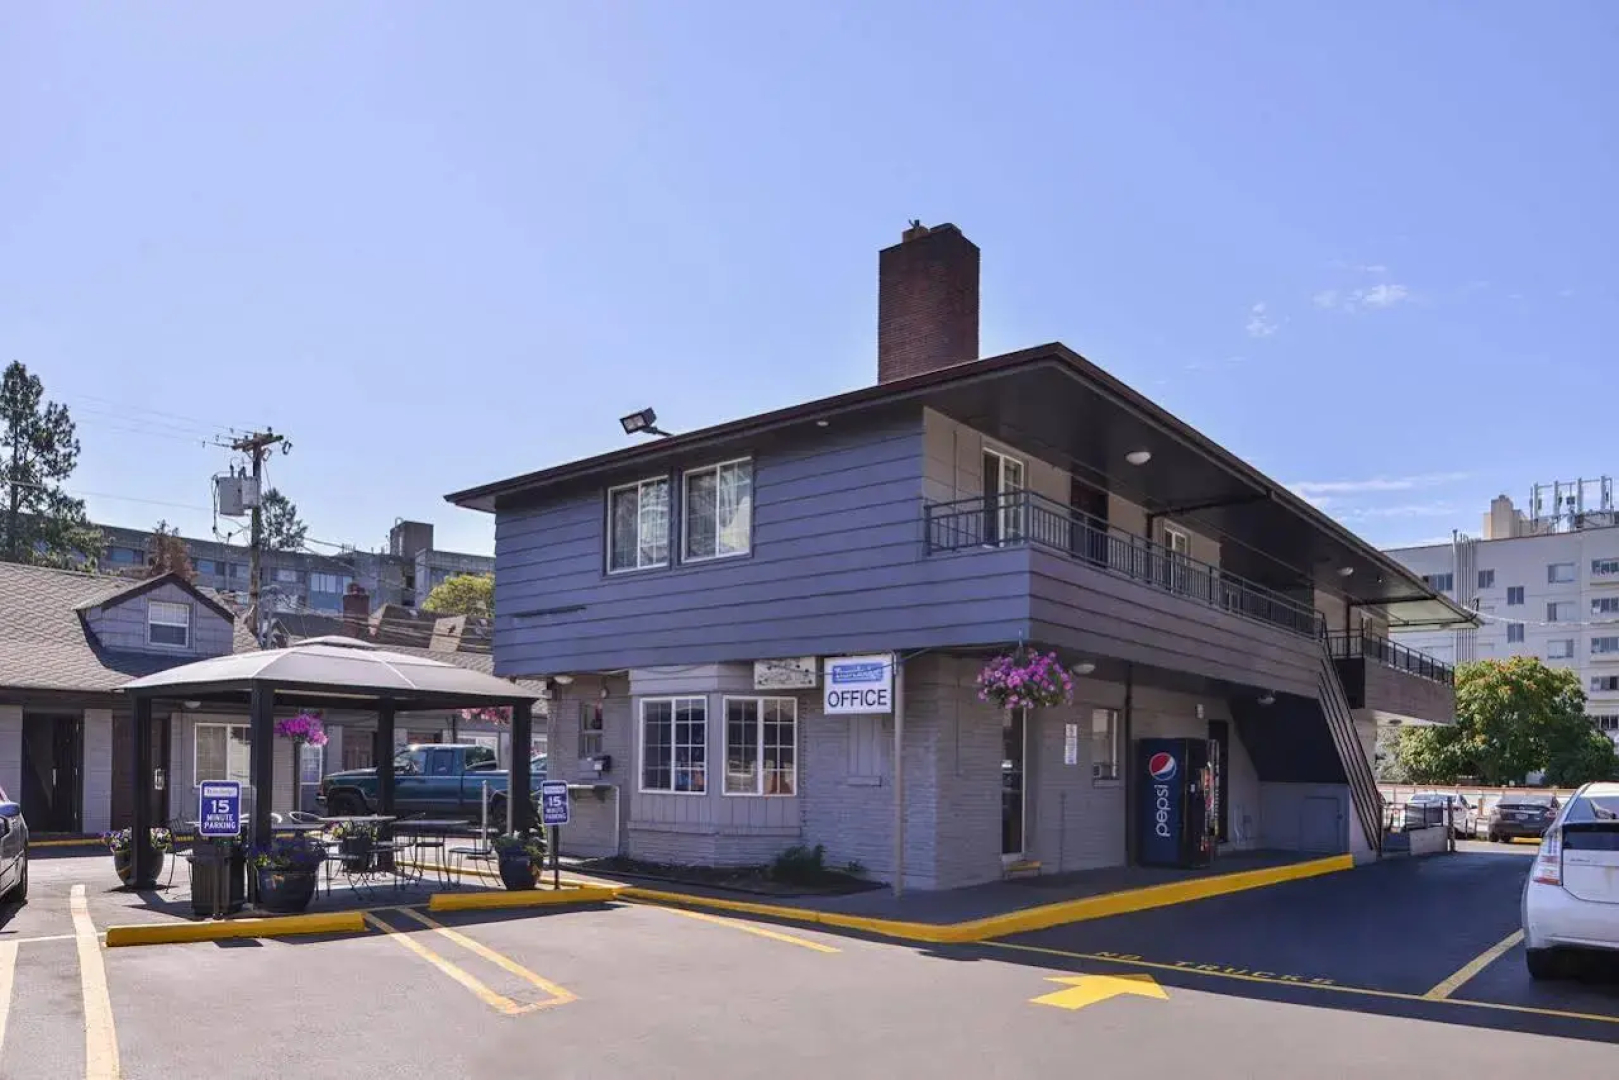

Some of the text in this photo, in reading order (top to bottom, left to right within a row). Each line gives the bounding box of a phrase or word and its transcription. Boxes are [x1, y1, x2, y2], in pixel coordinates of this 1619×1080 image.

[828, 689, 887, 708] OFFICE
[211, 799, 230, 814] 15
[548, 795, 562, 807] 15
[206, 813, 234, 821] MINUTE
[1154, 784, 1171, 837] pepsi
[204, 821, 236, 829] PARKING
